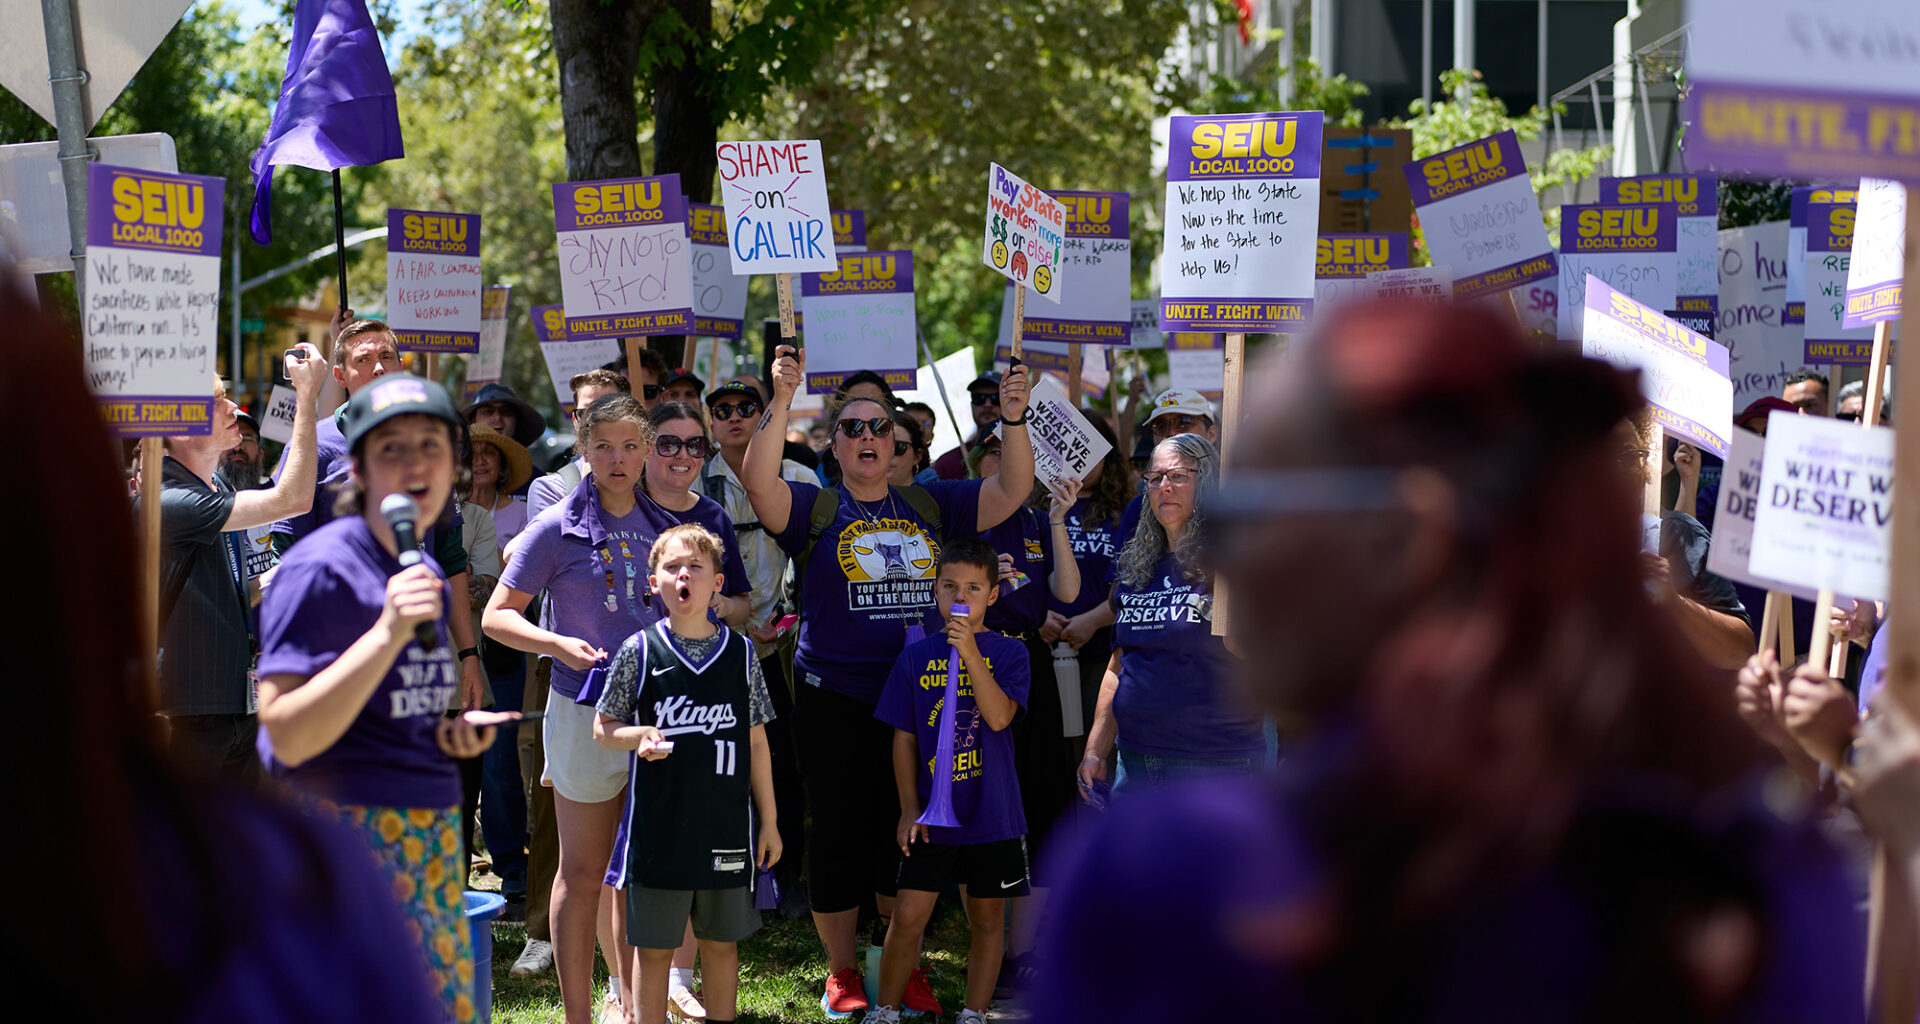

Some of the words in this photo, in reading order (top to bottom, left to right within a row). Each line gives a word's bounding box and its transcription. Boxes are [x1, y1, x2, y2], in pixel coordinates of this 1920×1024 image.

[1191, 120, 1297, 159] SEIU
[718, 143, 812, 181] SHAME
[1190, 159, 1244, 174] LOCAL
[1247, 158, 1294, 173] 1000
[1422, 140, 1503, 187] SEIU
[1178, 184, 1197, 205] We
[1201, 185, 1225, 205] help
[1231, 183, 1252, 201] the
[1258, 182, 1302, 202] State
[1428, 178, 1472, 198] LOCAL
[1472, 166, 1507, 184] 1000
[1617, 179, 1698, 204] SEIU
[112, 176, 205, 229] SEIU
[574, 182, 662, 214] SEIU
[754, 190, 785, 209] on
[996, 166, 1019, 206] Pay
[1020, 184, 1062, 226] State
[575, 212, 623, 226] LOCAL
[625, 209, 663, 222] 1000
[990, 195, 1037, 232] workers
[1038, 224, 1062, 249] more
[1056, 197, 1110, 223] EIU
[1210, 213, 1222, 226] is
[1226, 209, 1246, 226] the
[1253, 208, 1288, 225] time
[403, 215, 467, 242] SEIU
[991, 213, 1008, 244] $$
[1012, 231, 1026, 250] or
[1076, 224, 1110, 234] 1000
[1577, 209, 1658, 237] SEIU
[113, 223, 163, 244] LOCAL
[166, 228, 203, 248] 1000
[404, 239, 438, 251] LOCAL
[440, 241, 467, 252] 1000
[1181, 238, 1196, 252] for
[1200, 234, 1219, 249] the
[1227, 232, 1260, 247] State
[1269, 232, 1282, 246] to
[1576, 237, 1618, 248] LOCAL
[1621, 236, 1657, 248] 1000
[560, 233, 613, 277] SAY
[1316, 239, 1389, 264] SEIU
[93, 256, 121, 286] We
[128, 255, 157, 282] have
[162, 263, 194, 286] made
[395, 259, 405, 280] A
[410, 261, 438, 280] FAIR
[819, 256, 896, 282] SEIU
[1181, 262, 1206, 279] Help
[1316, 265, 1352, 275] OCAL
[1486, 269, 1521, 287] FIGHT.
[1521, 259, 1551, 276] WIN.
[398, 288, 431, 305] KEEPS
[819, 281, 860, 292] LOCAL
[864, 280, 896, 290] 1000
[1377, 287, 1415, 299] WHAT
[1420, 285, 1442, 295] WE
[156, 290, 181, 312] while
[414, 306, 460, 319] WORKING
[1165, 304, 1213, 319] UNITE.
[1217, 304, 1263, 320] FIGHT.
[1266, 305, 1306, 320] WIN.
[1847, 294, 1874, 314] UNITE.
[1874, 287, 1903, 307] FIGHT.
[88, 314, 145, 338] California
[570, 319, 613, 333] UNITE.
[615, 317, 654, 330] FIGHT.
[656, 314, 687, 327] WIN.
[1059, 324, 1094, 335] FIGHT.
[1095, 325, 1126, 336] WIN.
[1609, 307, 1665, 342] LOCAL
[1664, 336, 1708, 364] 1000
[1610, 291, 1706, 356] SEIU
[425, 334, 454, 346] FIGHT.
[454, 336, 476, 347] WIN.
[1809, 344, 1854, 356] UNITE.
[89, 342, 115, 363] time
[121, 348, 131, 361] to
[134, 346, 153, 368] pay
[884, 374, 913, 383] WIN.
[141, 404, 180, 422] FIGHT.
[181, 405, 209, 422] WIN.
[1047, 400, 1079, 432] FIGHTING
[1077, 430, 1091, 444] FOR
[1023, 405, 1087, 474] DESERVE
[1035, 400, 1072, 437] WHAT
[1071, 437, 1091, 460] WE
[1649, 405, 1689, 430] IGHT.
[1690, 425, 1726, 454] WIN.
[1785, 460, 1856, 489] WHAT
[1869, 474, 1896, 495] W
[1771, 484, 1894, 527] DESERV
[1087, 532, 1111, 543] WE
[857, 583, 889, 595] YOU'RE
[891, 581, 933, 593] PROBABLY
[857, 594, 873, 606] ON
[876, 593, 899, 604] THE
[901, 591, 931, 604] MENU
[1121, 594, 1167, 607] WHAT
[1171, 593, 1188, 604] W
[1173, 585, 1192, 594] FOR
[654, 694, 737, 736] Kings
[927, 709, 938, 727] AND
[714, 739, 736, 776] 11
[952, 772, 969, 782] OCAL
